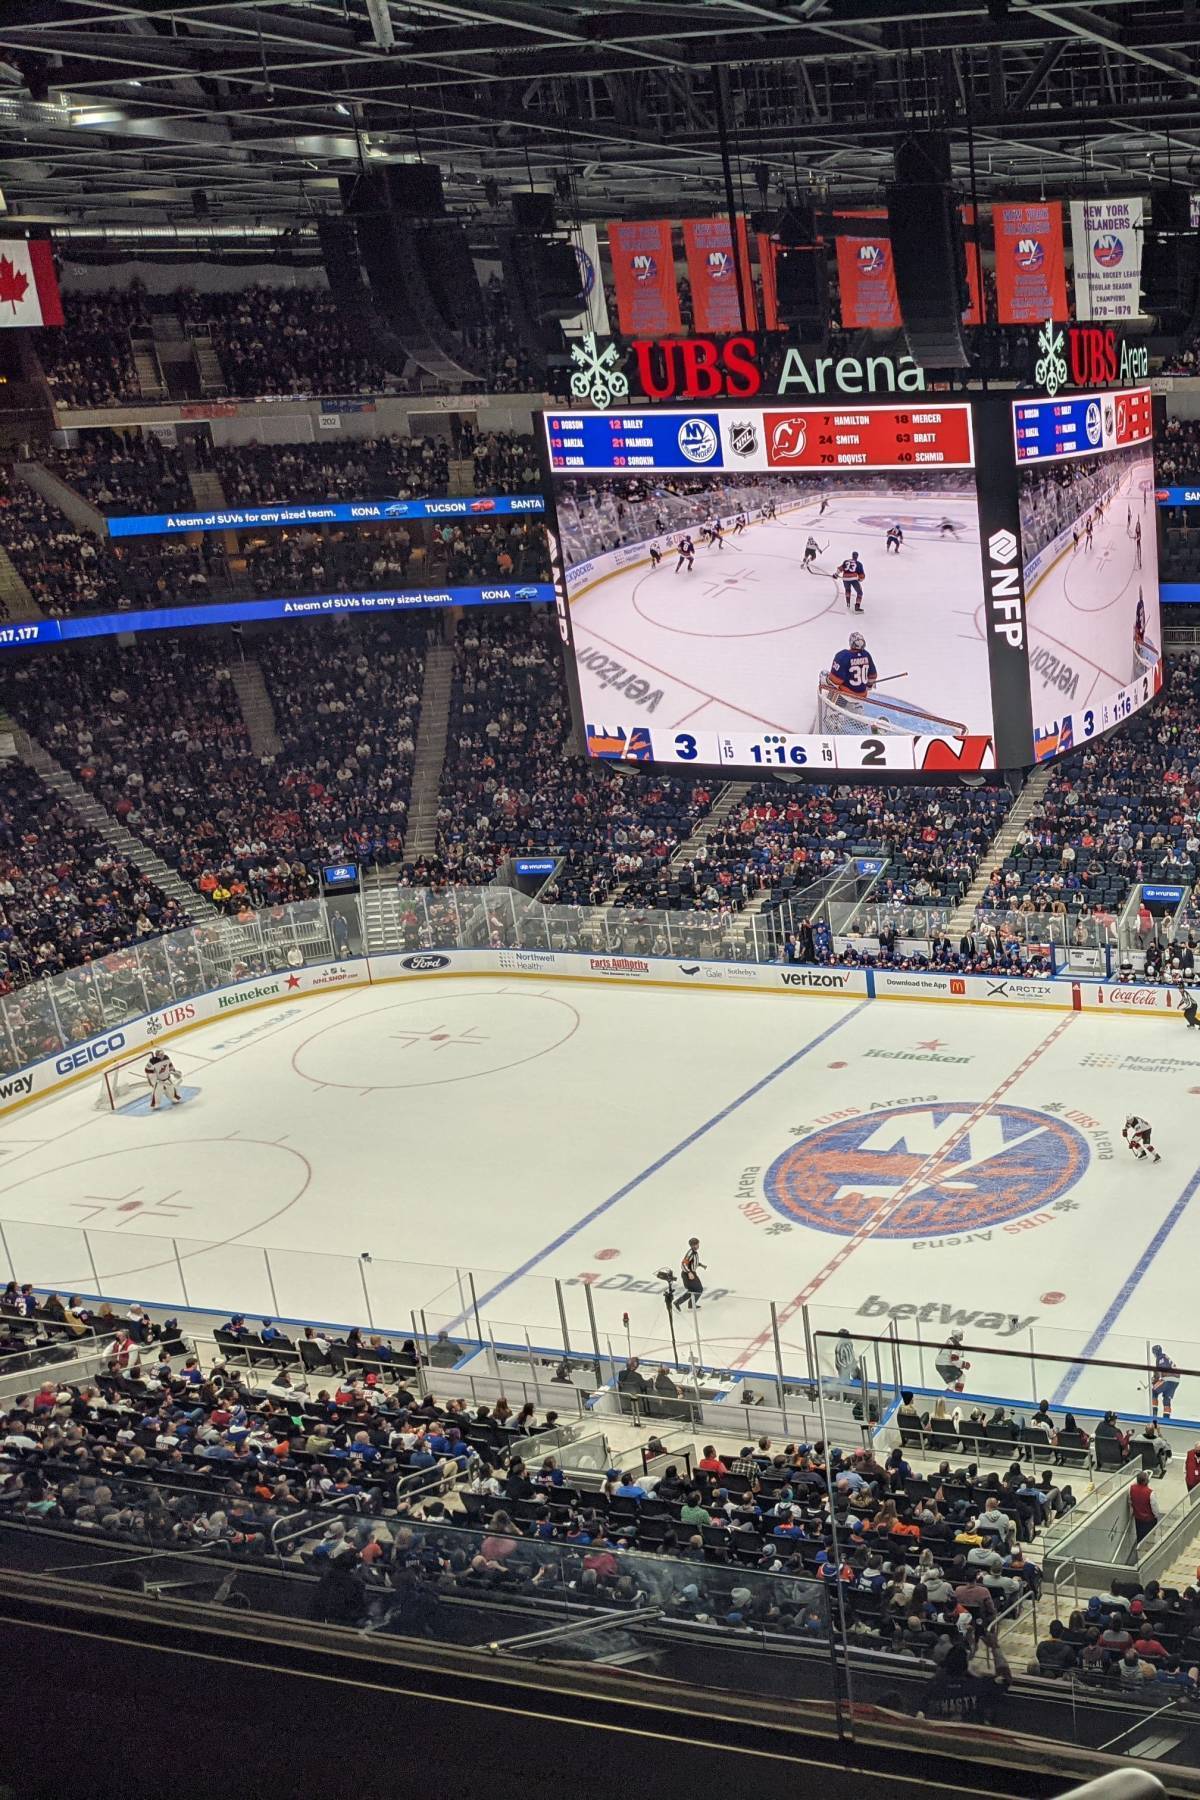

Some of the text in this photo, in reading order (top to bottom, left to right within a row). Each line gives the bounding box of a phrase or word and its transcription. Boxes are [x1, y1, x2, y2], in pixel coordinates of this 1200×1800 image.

[1083, 204, 1129, 217] NEW YORK
[1084, 218, 1131, 231] ISLANDERS
[1069, 328, 1148, 386] UBS Arena
[632, 337, 926, 398] UBS Arena
[609, 419, 643, 429] 12 BAILEY
[834, 415, 870, 426] HAMILTON
[912, 413, 942, 424] MERCER
[612, 438, 654, 448] 21 PALMIERI
[818, 434, 860, 445] 24 SMITH
[896, 433, 936, 443] 63 BRATT
[820, 453, 867, 465] 70 BOQVIST
[915, 451, 944, 462] SCHMID
[351, 507, 380, 517] KONA
[425, 503, 466, 514] TUCSON
[510, 499, 541, 510] SANTA
[481, 590, 511, 600] KONA
[990, 568, 1025, 648] NFP
[577, 646, 665, 714] verizon
[849, 664, 870, 686] 30
[1113, 699, 1132, 721] 1:16
[1083, 710, 1094, 737] 3
[674, 733, 698, 760] 3
[750, 744, 807, 764] 1:16
[860, 739, 887, 766] 2
[409, 955, 442, 970] Ford
[515, 952, 555, 962] Northwell
[590, 958, 649, 971] Parts Authority
[517, 962, 543, 970] Health
[780, 971, 844, 987] verizon
[886, 978, 947, 990] Download the App
[217, 982, 279, 1009] Heineken
[1009, 984, 1051, 994] ARCTIX
[162, 1003, 196, 1027] UBS
[55, 1031, 126, 1076] GEICO
[862, 1047, 973, 1066] Heineken
[1118, 1062, 1177, 1075] Health
[814, 1094, 939, 1125] UBS Arena
[1064, 1109, 1114, 1161] UBS Arena
[734, 1165, 773, 1225] UBS Arena
[911, 1212, 1057, 1251] UBS Arena
[855, 1295, 1040, 1336] betway
